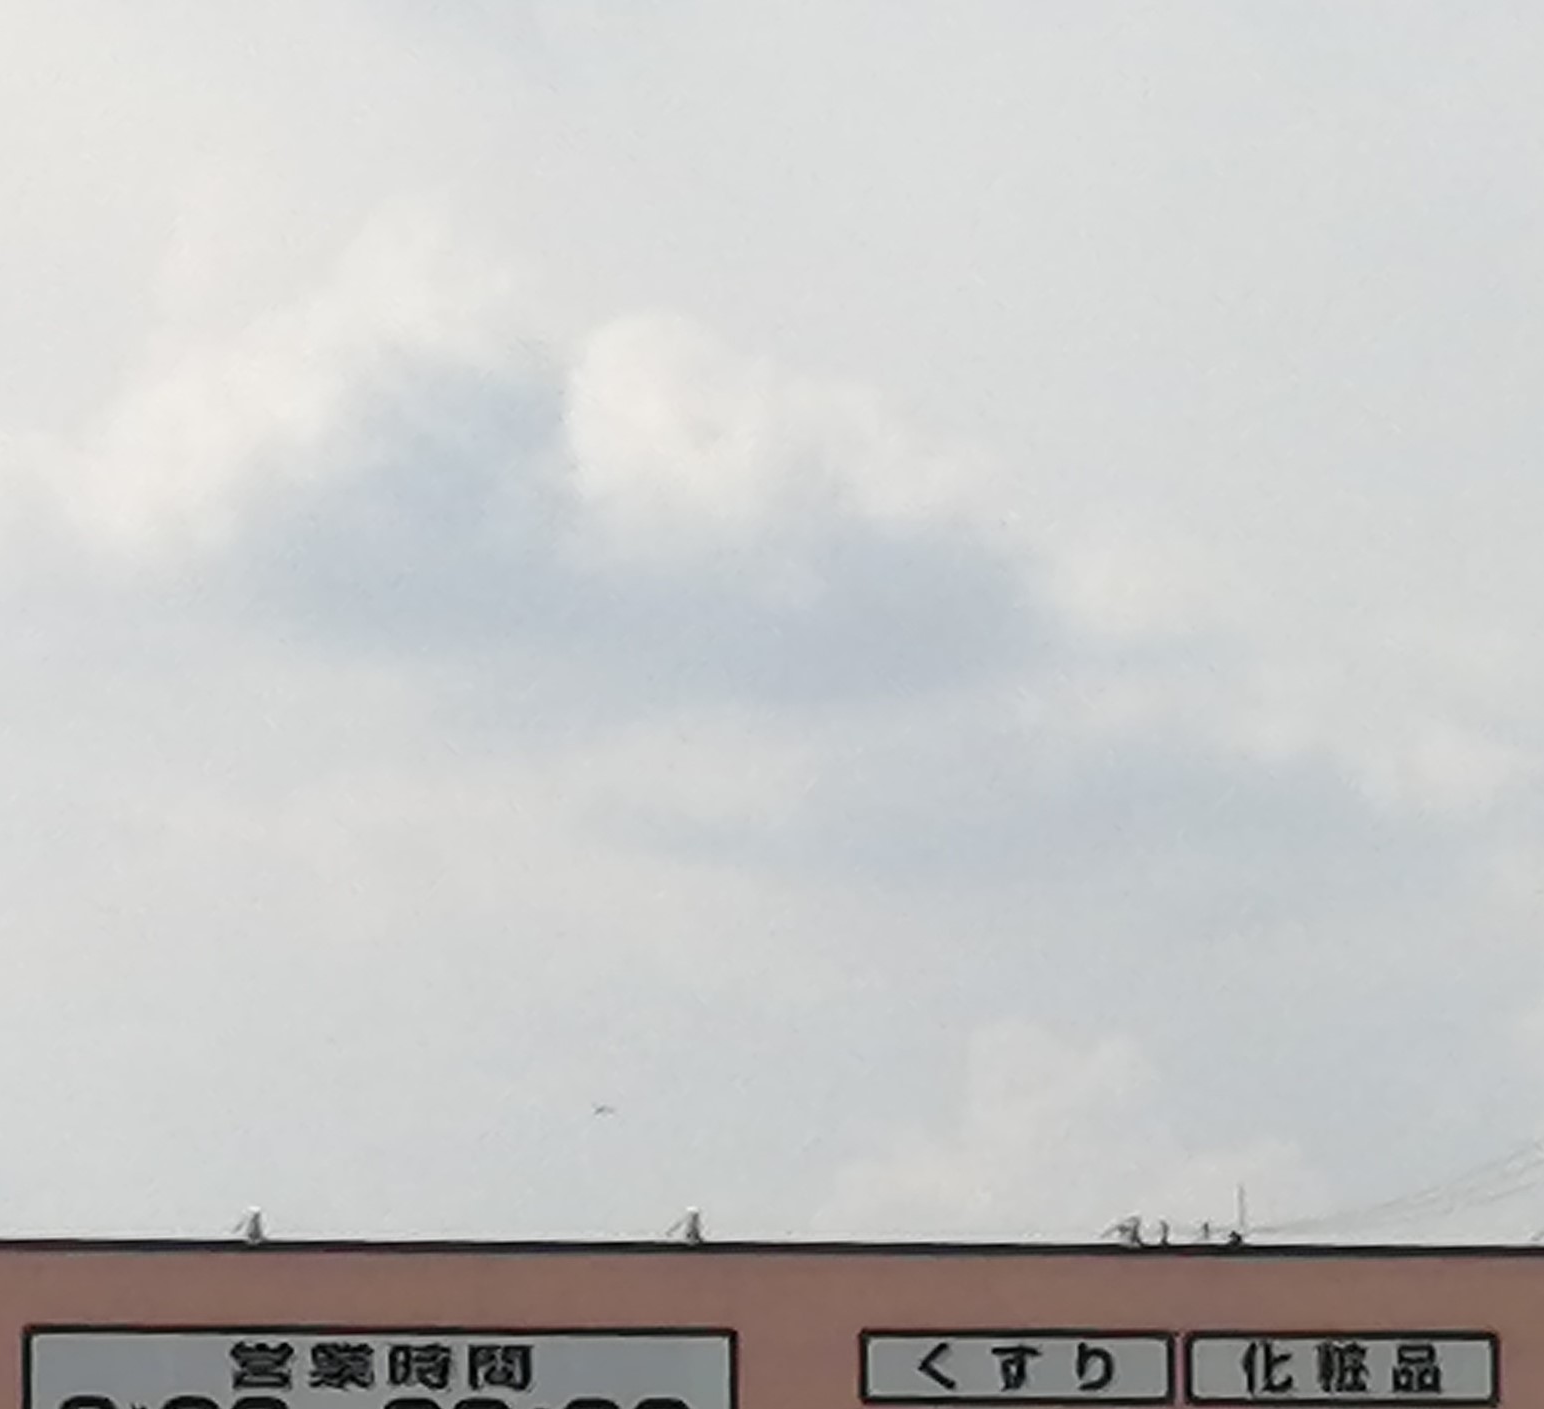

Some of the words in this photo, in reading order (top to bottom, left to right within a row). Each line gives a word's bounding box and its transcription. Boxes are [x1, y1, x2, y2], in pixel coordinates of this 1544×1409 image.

[229, 1343, 533, 1390] 営業時間
[916, 1340, 1116, 1391] くすり
[1241, 1340, 1444, 1394] 化粧品
